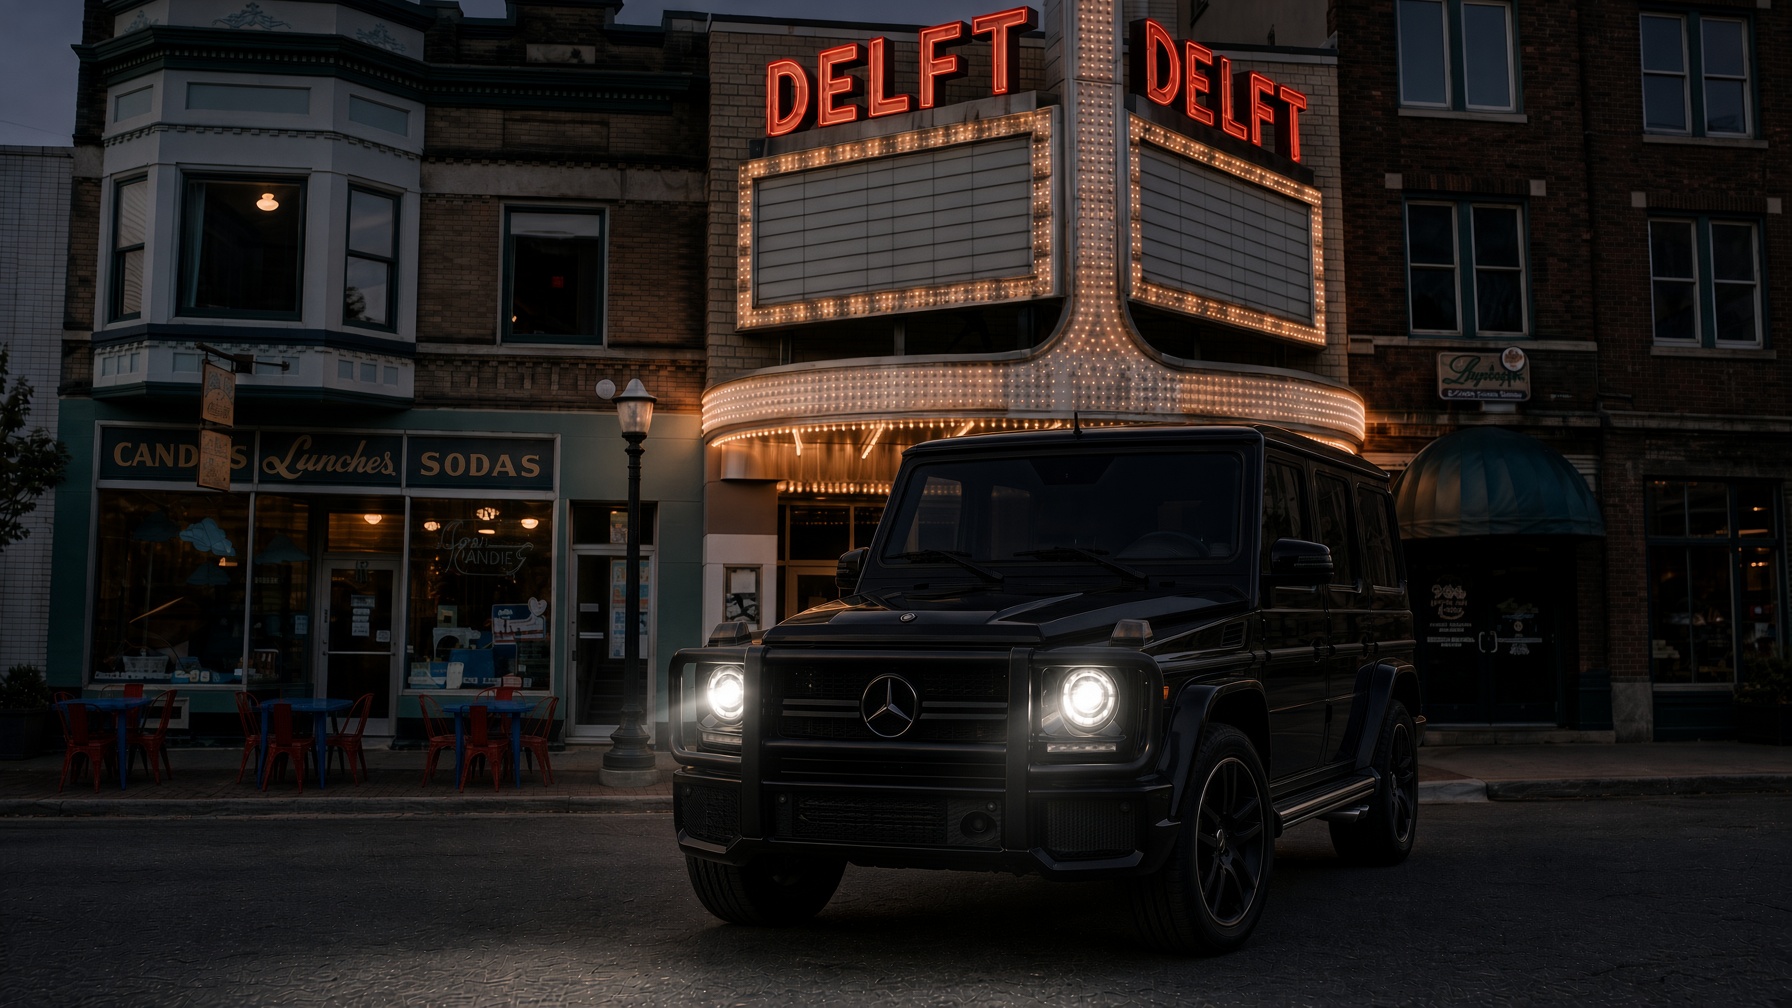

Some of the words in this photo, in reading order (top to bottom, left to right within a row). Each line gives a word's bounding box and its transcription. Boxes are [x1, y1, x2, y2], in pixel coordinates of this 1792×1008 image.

[766, 6, 1037, 137] DELFT
[1146, 18, 1307, 163] DELFT
[113, 442, 247, 470] CANDS
[262, 434, 396, 479] Lunches
[420, 452, 541, 478] SODAS
